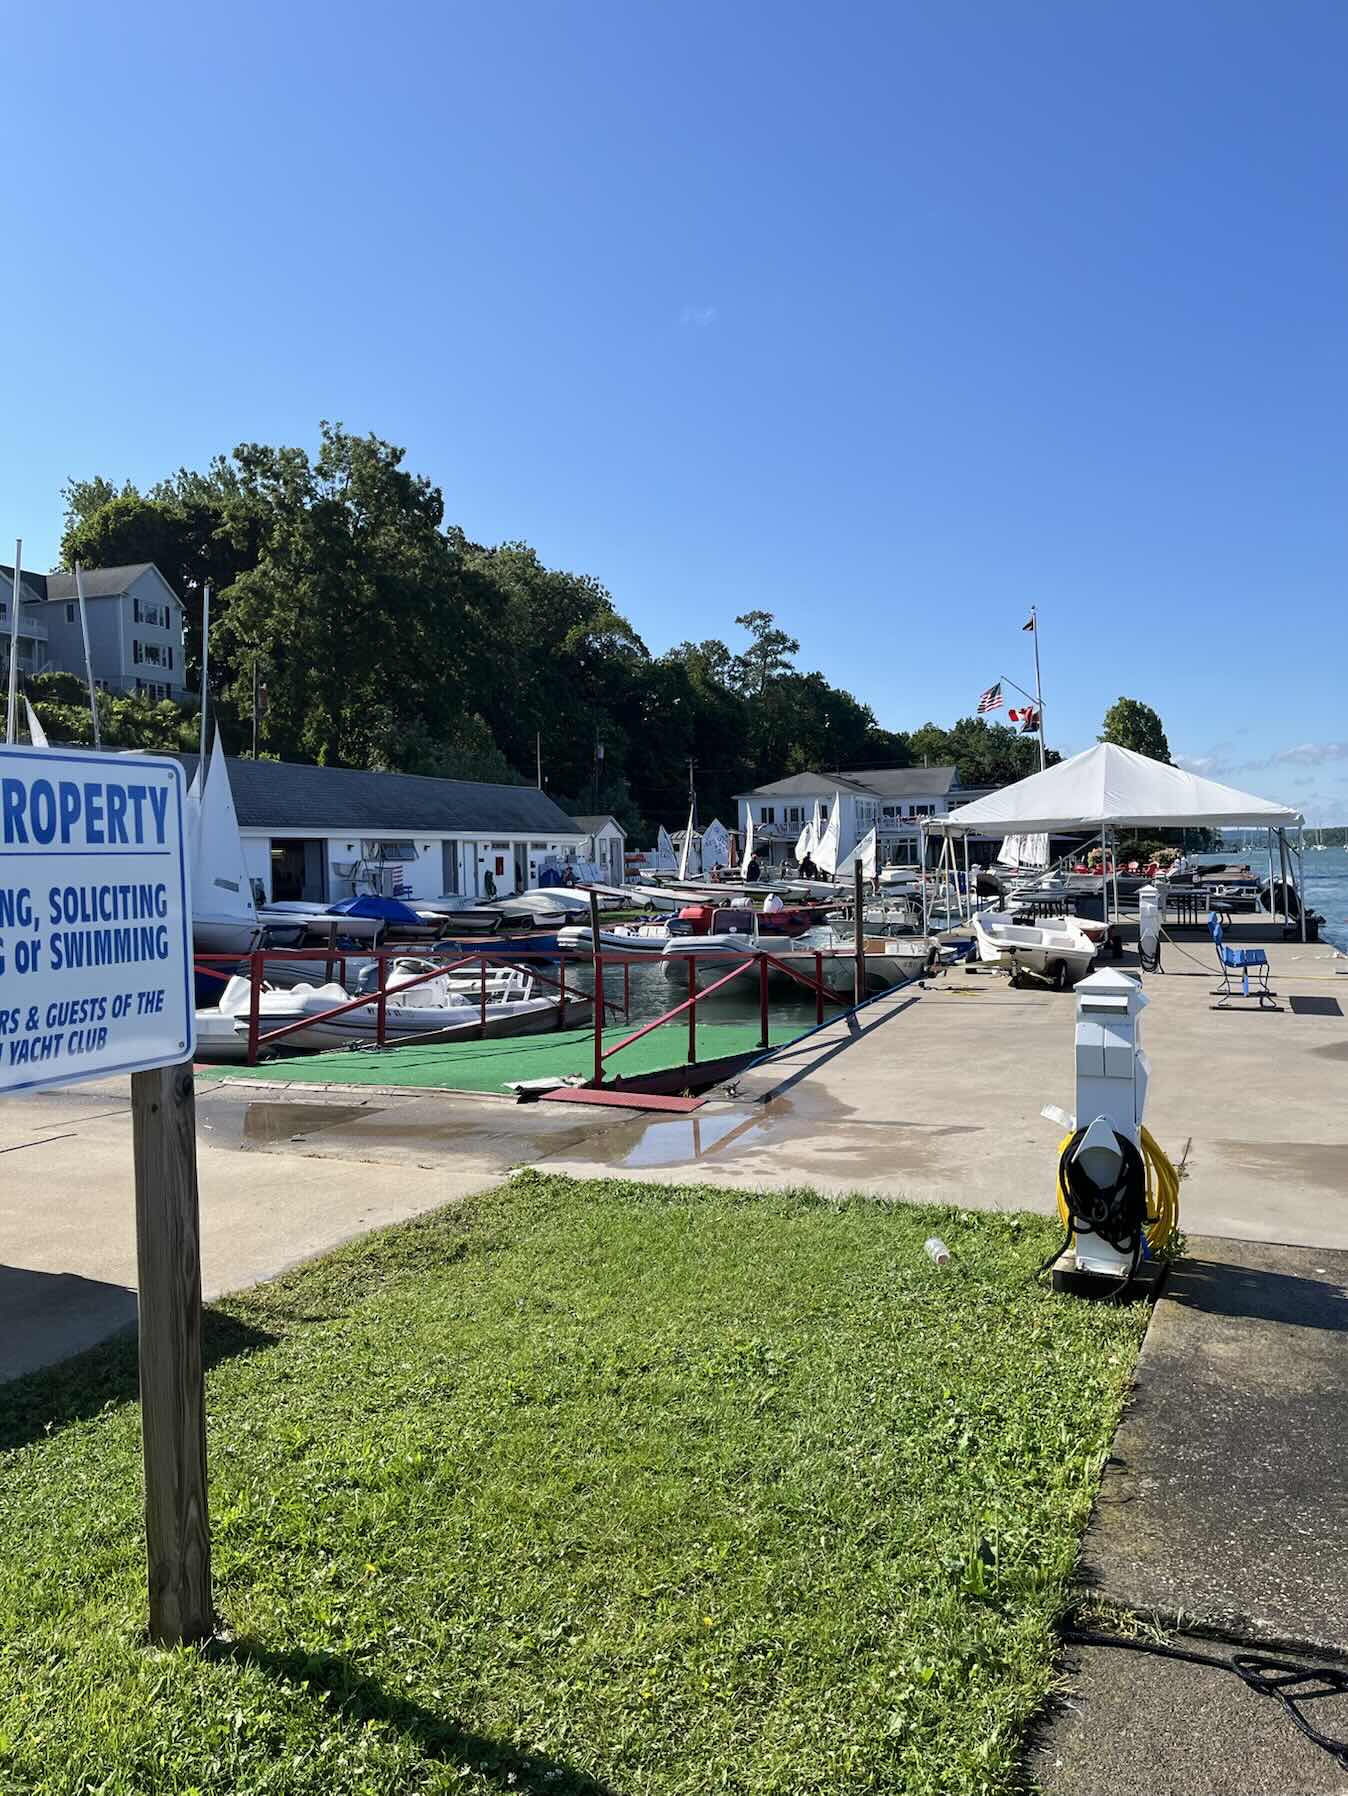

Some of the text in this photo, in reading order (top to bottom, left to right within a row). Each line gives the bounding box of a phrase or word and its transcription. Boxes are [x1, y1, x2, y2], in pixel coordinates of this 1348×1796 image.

[49, 883, 168, 925] SOLICITING
[15, 939, 41, 974] or
[50, 925, 169, 970] SWIMMING
[25, 1005, 39, 1031] &
[46, 996, 107, 1028] GUESTS
[112, 994, 132, 1018] OF
[137, 990, 165, 1015] THE
[10, 1033, 64, 1065] YACHT
[68, 1027, 107, 1057] CLUB
